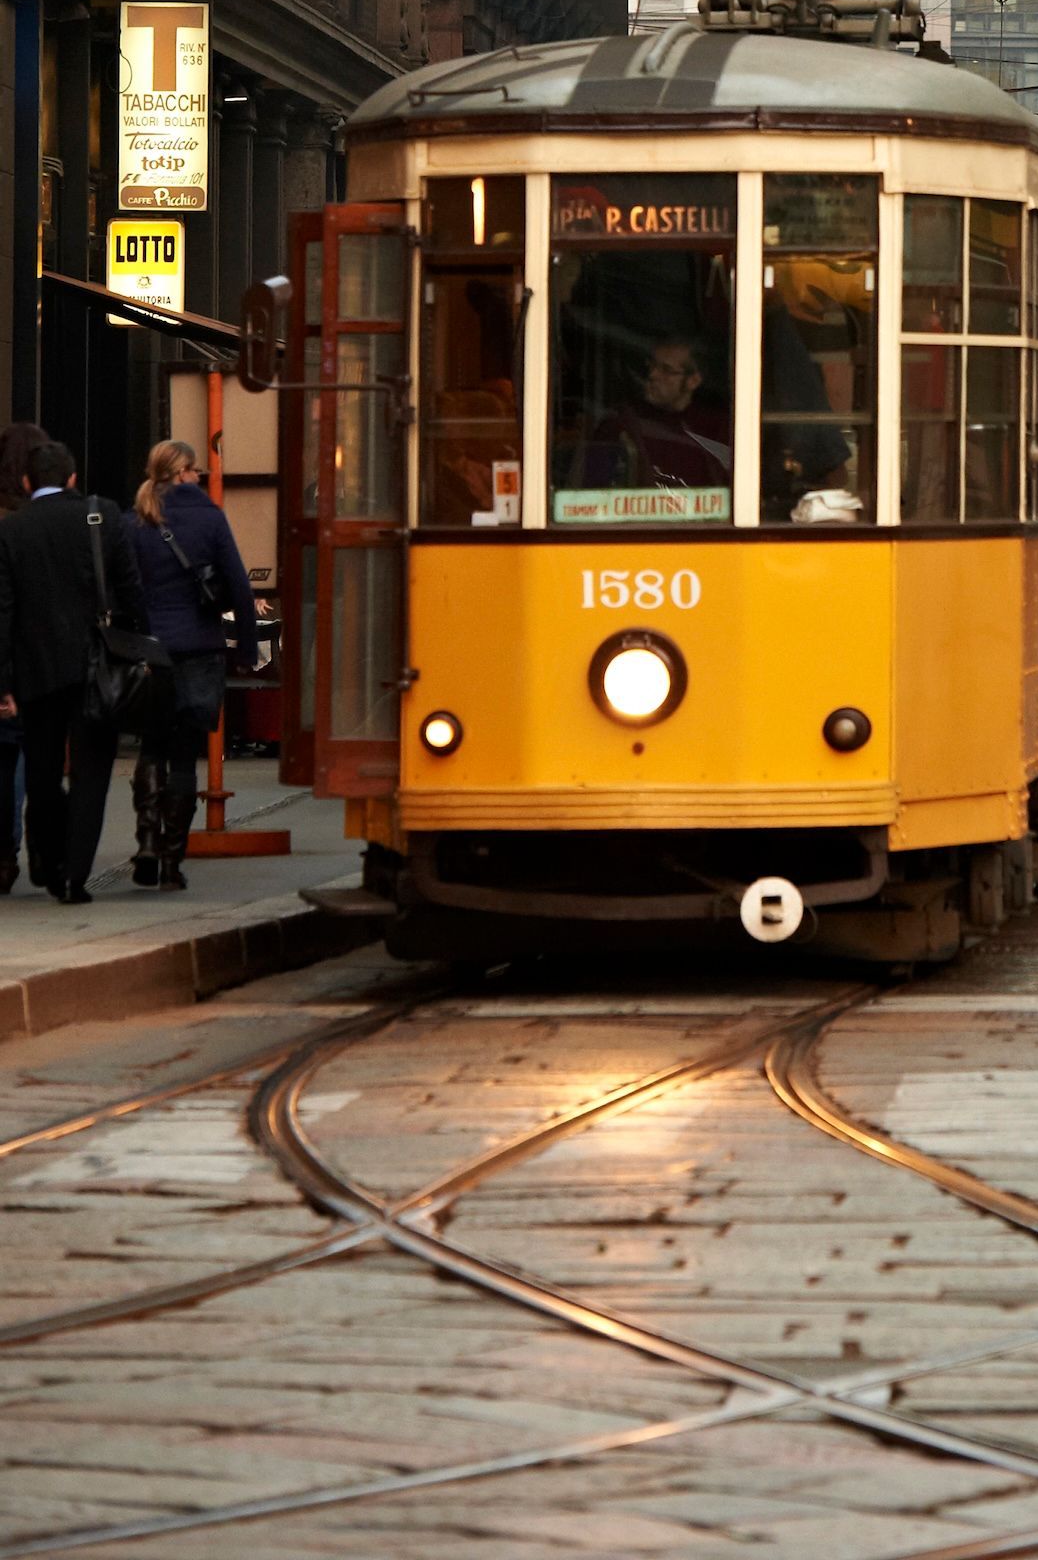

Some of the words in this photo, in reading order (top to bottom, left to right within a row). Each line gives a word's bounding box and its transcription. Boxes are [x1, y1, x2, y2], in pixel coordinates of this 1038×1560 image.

[127, 5, 204, 92] T
[182, 55, 203, 66] 636
[122, 94, 206, 112] TABACCHI
[123, 116, 160, 127] VALORI
[164, 117, 206, 128] BOLLATI
[124, 131, 200, 150] Totocalcio
[141, 155, 186, 171] totip
[153, 187, 198, 206] Picchio
[605, 206, 623, 234] P.
[629, 206, 729, 233] CASTELLI
[116, 236, 175, 263] LOTTO
[581, 569, 701, 609] 1580
